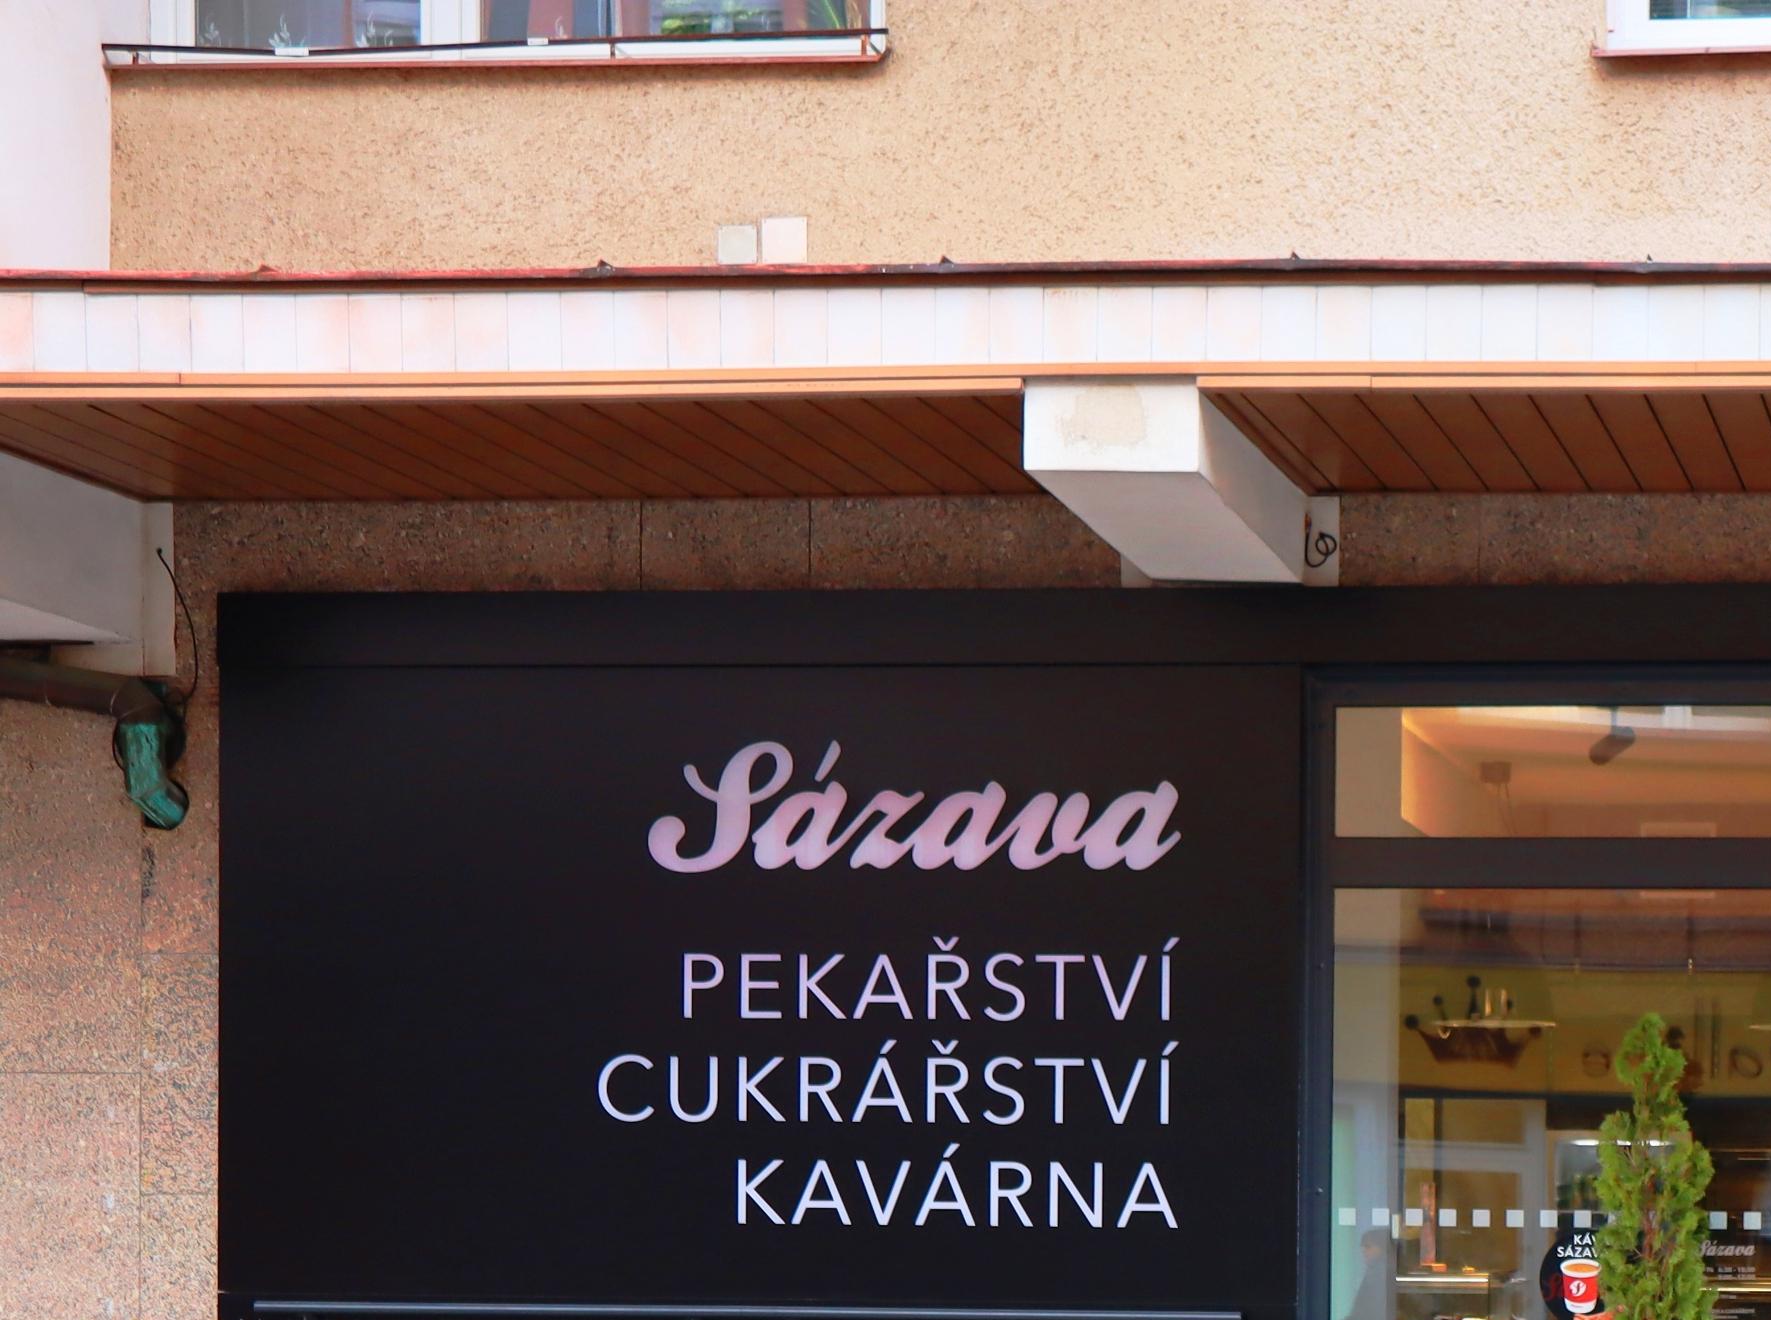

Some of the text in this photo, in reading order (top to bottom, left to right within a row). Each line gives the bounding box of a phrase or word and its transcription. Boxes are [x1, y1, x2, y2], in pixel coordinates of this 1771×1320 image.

[647, 740, 1181, 873] Sázava
[681, 936, 1180, 1021] PEKAŘSTVÍ
[597, 1039, 1179, 1125] CUKRÁŘSTVÍ
[735, 1143, 1179, 1228] KAVÁRNA
